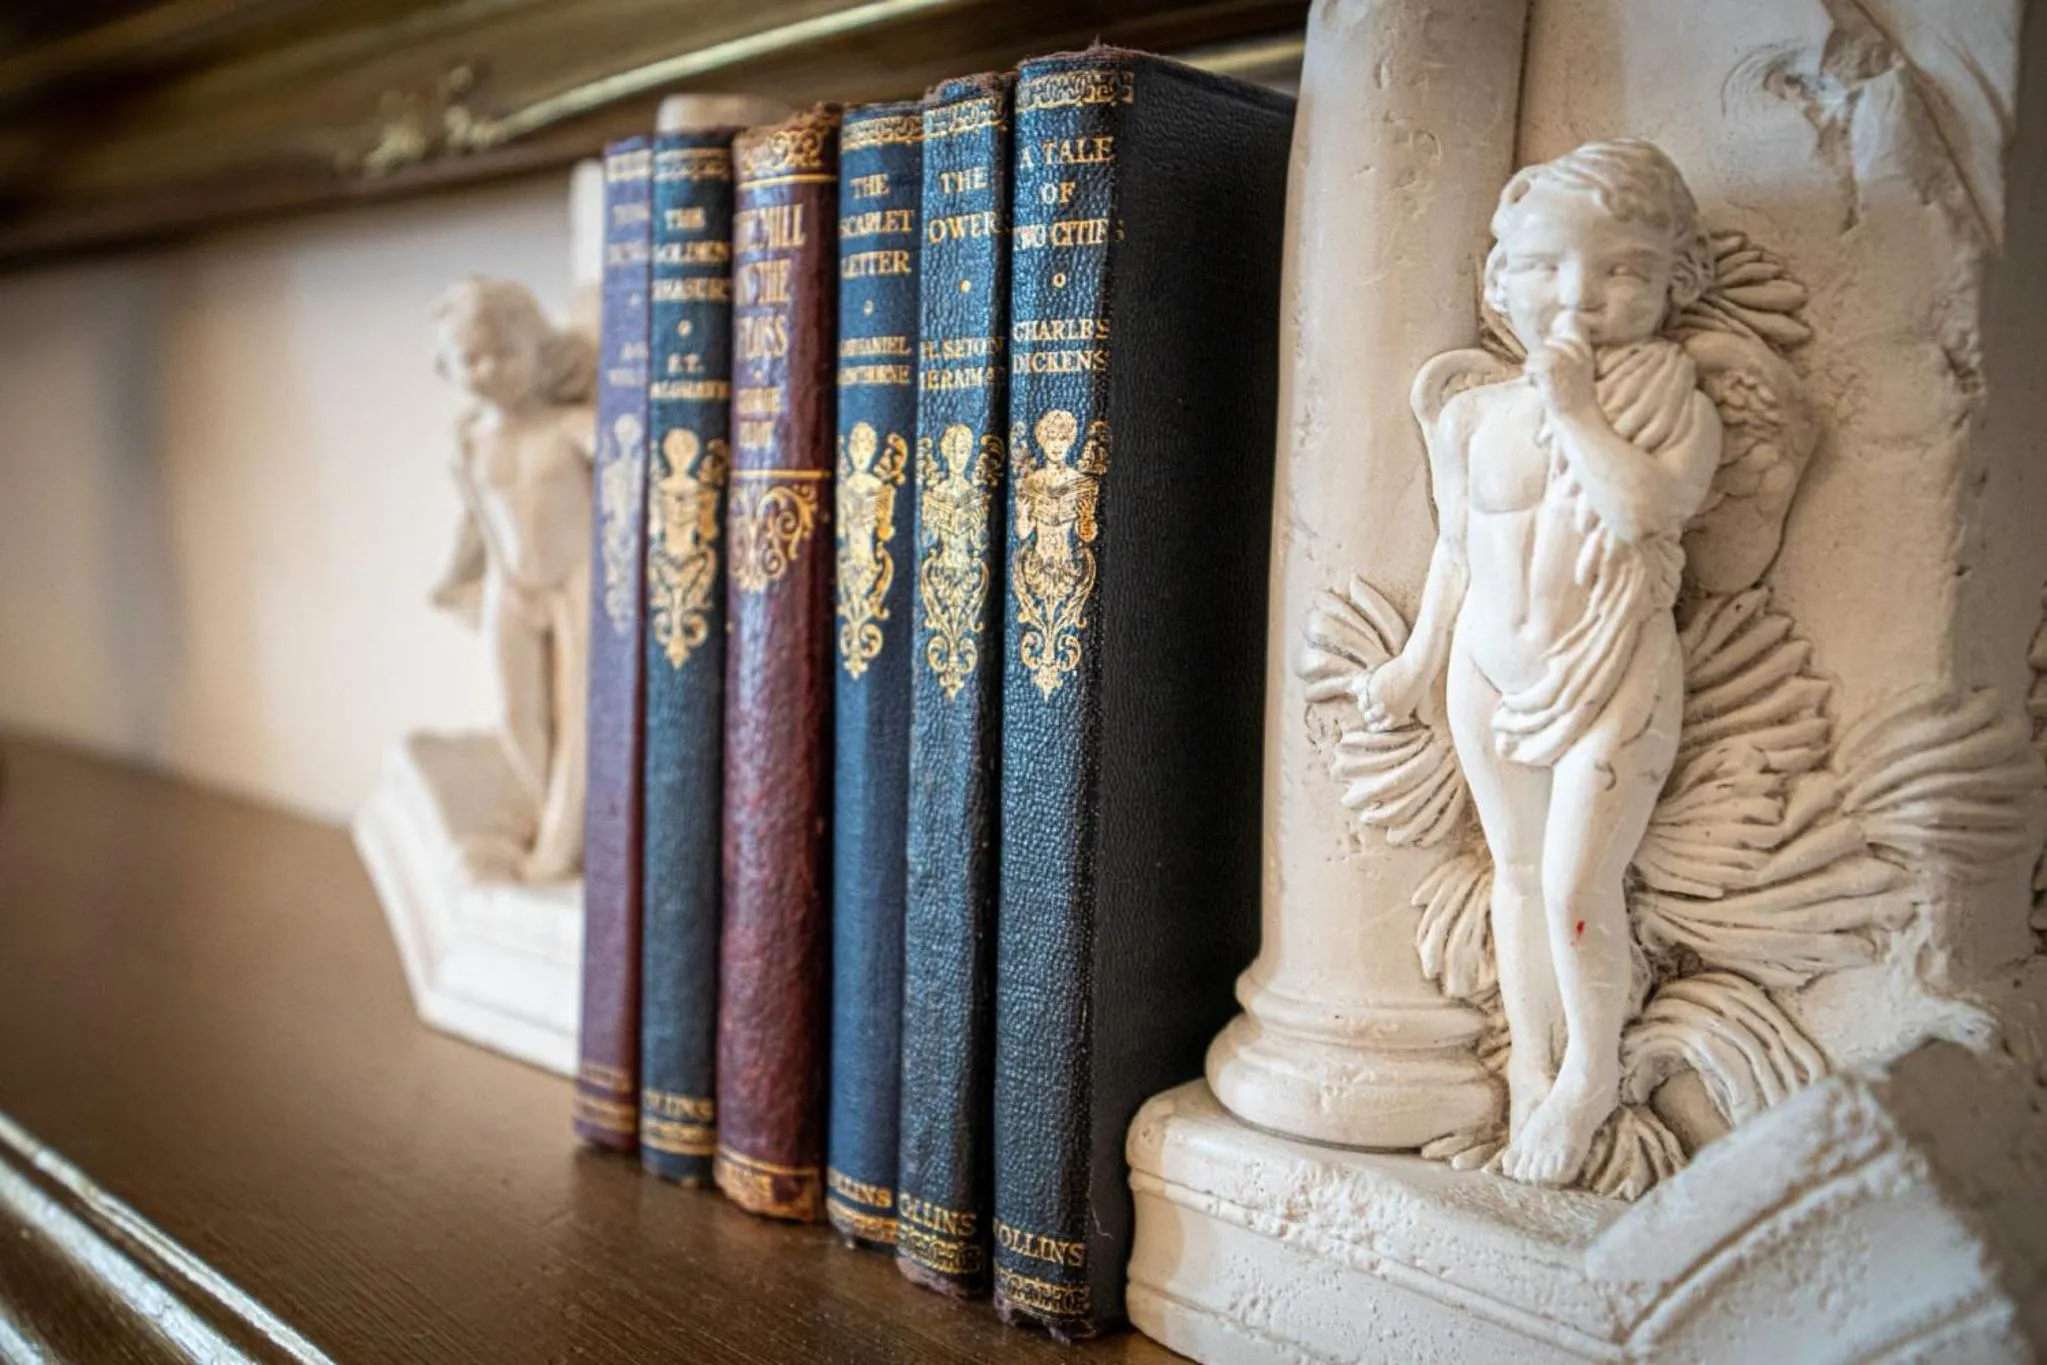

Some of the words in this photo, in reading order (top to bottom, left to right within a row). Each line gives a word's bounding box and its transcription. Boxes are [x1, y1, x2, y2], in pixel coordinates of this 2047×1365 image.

[1019, 145, 1035, 171] A
[1041, 135, 1117, 166] TALE
[850, 172, 890, 199] THE
[940, 166, 989, 194] THE
[1040, 180, 1077, 205] OF
[927, 209, 1005, 244] OWER
[1012, 317, 1112, 343] CHARLES
[1012, 348, 1110, 375] DICKENS
[898, 1191, 978, 1237] OLLINS
